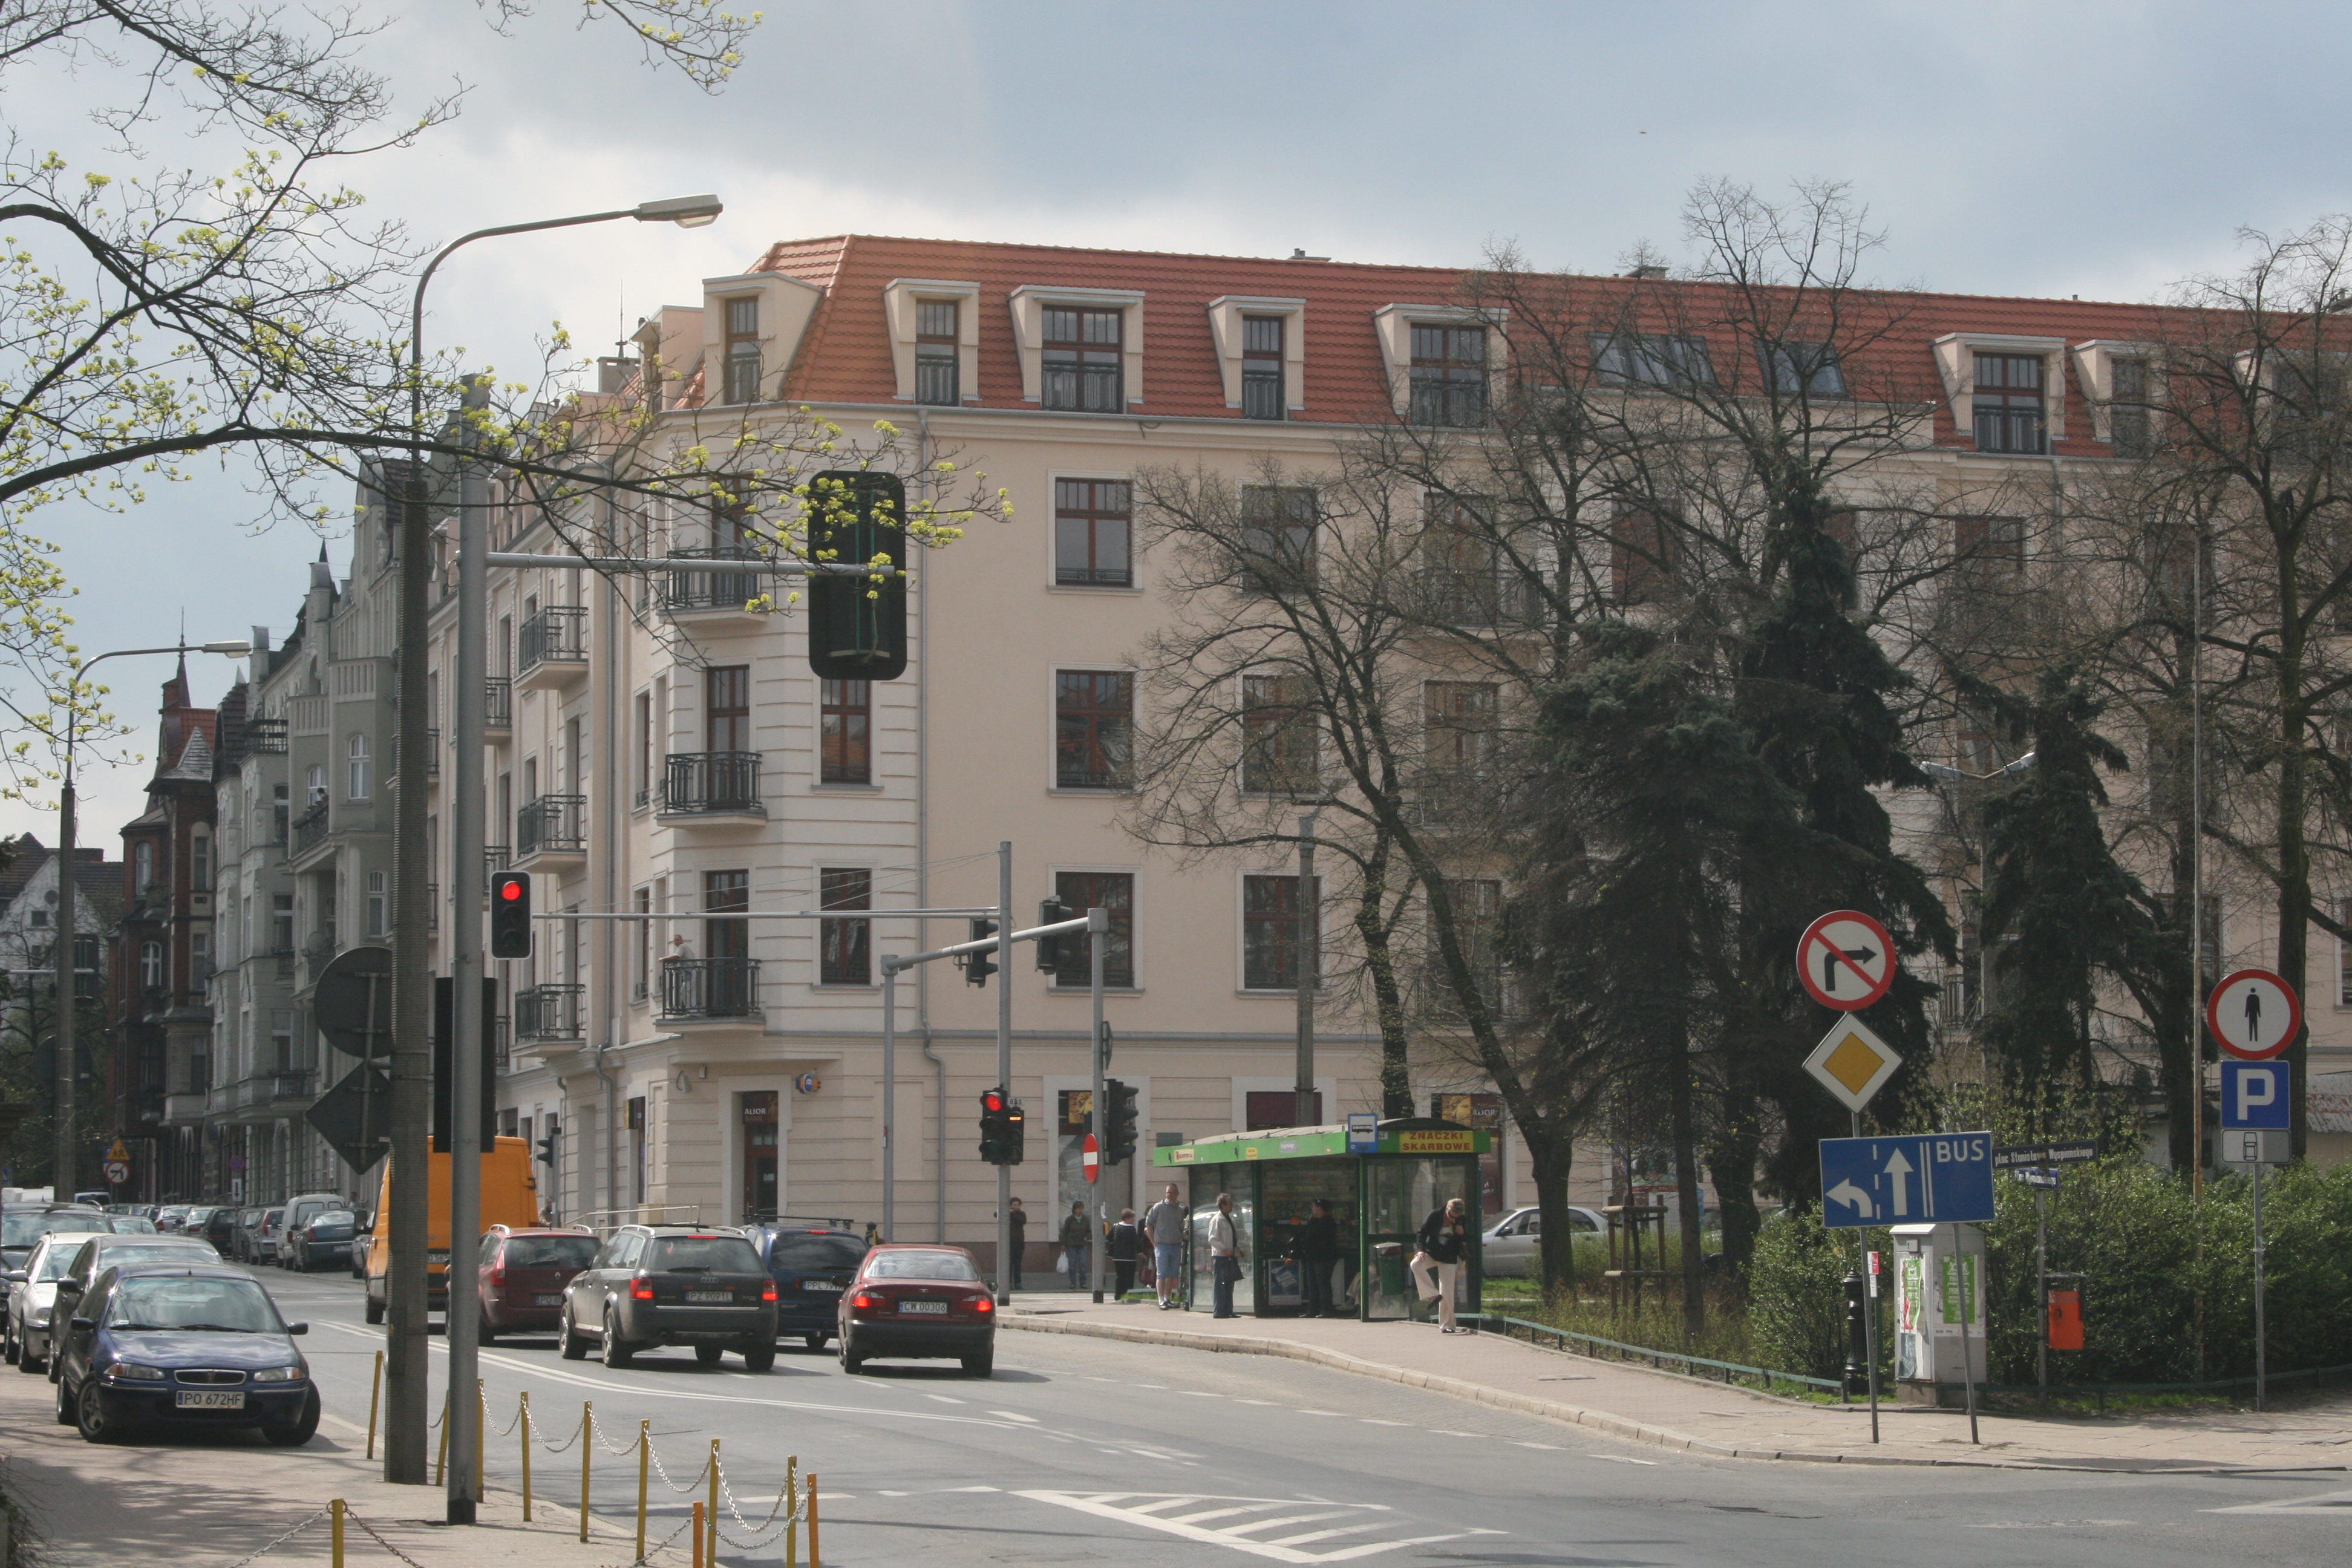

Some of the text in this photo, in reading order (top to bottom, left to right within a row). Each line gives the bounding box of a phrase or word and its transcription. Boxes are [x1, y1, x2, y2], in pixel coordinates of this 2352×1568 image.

[2236, 1068, 2275, 1120] P
[1410, 1132, 1463, 1140] ZNACZKI
[1402, 1142, 1470, 1151] SKARBOWE
[1936, 1139, 1984, 1163] BUS
[1994, 1147, 2093, 1167] plac Stanisława Wyspiańskiego
[807, 1281, 823, 1290] PPL
[904, 1302, 946, 1312] CW 00306
[184, 1393, 242, 1405] PO 672HF
